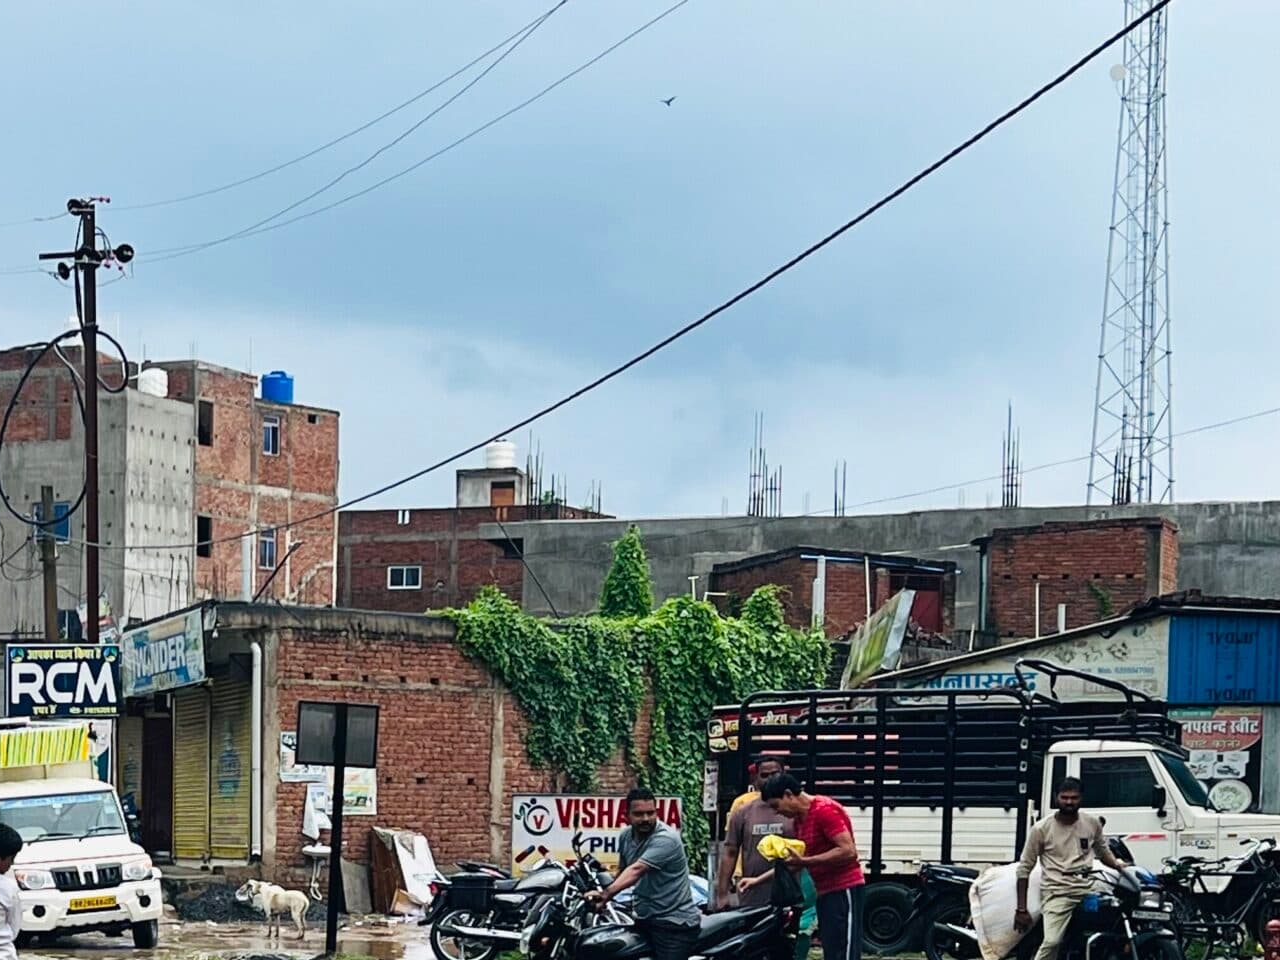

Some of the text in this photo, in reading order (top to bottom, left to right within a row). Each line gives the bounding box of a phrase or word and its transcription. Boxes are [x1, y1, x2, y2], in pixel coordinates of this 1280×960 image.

[11, 661, 117, 704] RCM
[1182, 719, 1226, 733] नपसन्द
[555, 798, 682, 829] VISHAHA
